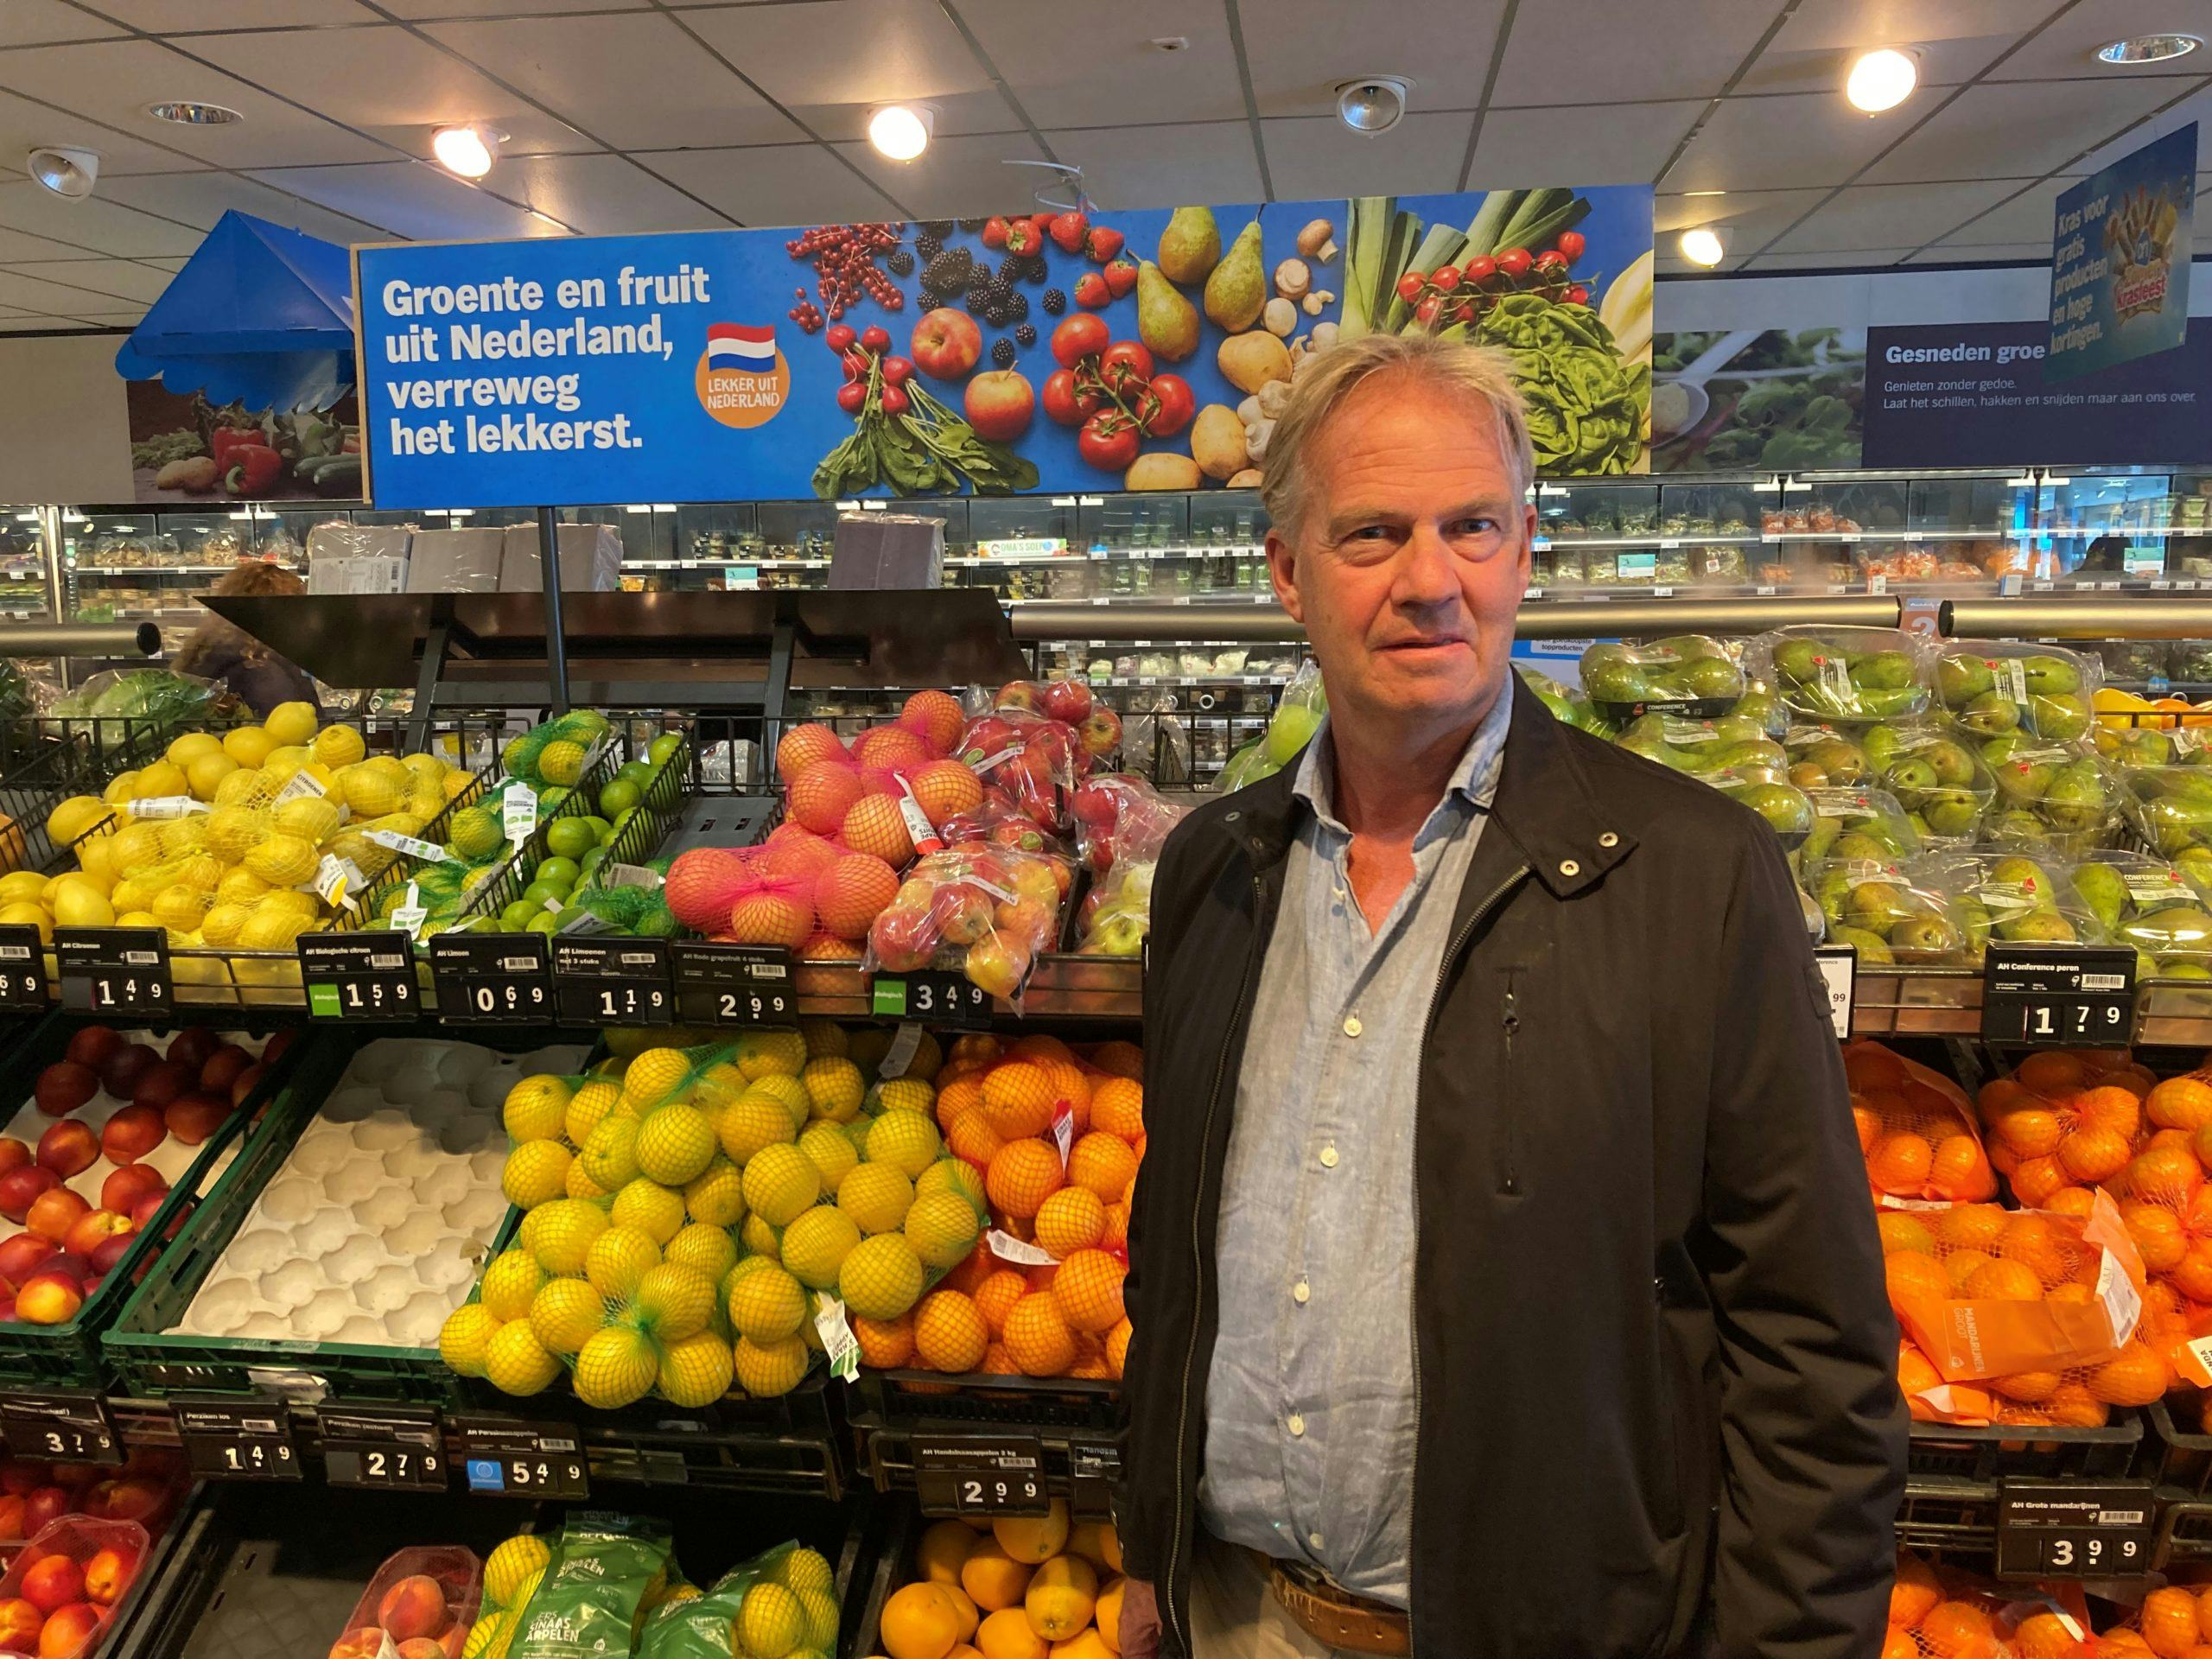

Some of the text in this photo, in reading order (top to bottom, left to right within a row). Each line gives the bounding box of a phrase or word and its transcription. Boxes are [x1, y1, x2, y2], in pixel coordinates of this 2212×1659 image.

[2058, 194, 2109, 238] Kras voor
[2056, 232, 2085, 272] gratis
[383, 264, 710, 317] Groente en fruit
[2055, 257, 2108, 302] producten
[2052, 293, 2094, 327] en hoge
[386, 314, 674, 364] uit Nederland,
[1885, 343, 1990, 364] Gesneden
[386, 372, 581, 411] verreweg
[707, 391, 779, 410] NEDERLAND
[708, 376, 779, 393] LEKKER UIT
[1884, 397, 1908, 409] Laat
[1910, 397, 1929, 408] het
[1931, 395, 1977, 409] schillen,
[1980, 394, 2022, 407] hakken
[2025, 396, 2039, 405] en
[2043, 392, 2084, 407] snijden
[2088, 394, 2118, 404] maar
[2121, 392, 2142, 403] aan
[2145, 391, 2167, 403] ons
[1885, 377, 2018, 392] Genieten zonder gedoe.
[391, 414, 643, 455] het lekkerst.
[296, 773, 323, 798] CITROENEN
[1998, 963, 2080, 973] AH Conference peren
[1833, 994, 1846, 1002] 99
[1954, 1307, 1967, 1340] GROOT
[1964, 1306, 1986, 1372] MANDARIJNEN
[530, 1617, 570, 1631] SINAAS
